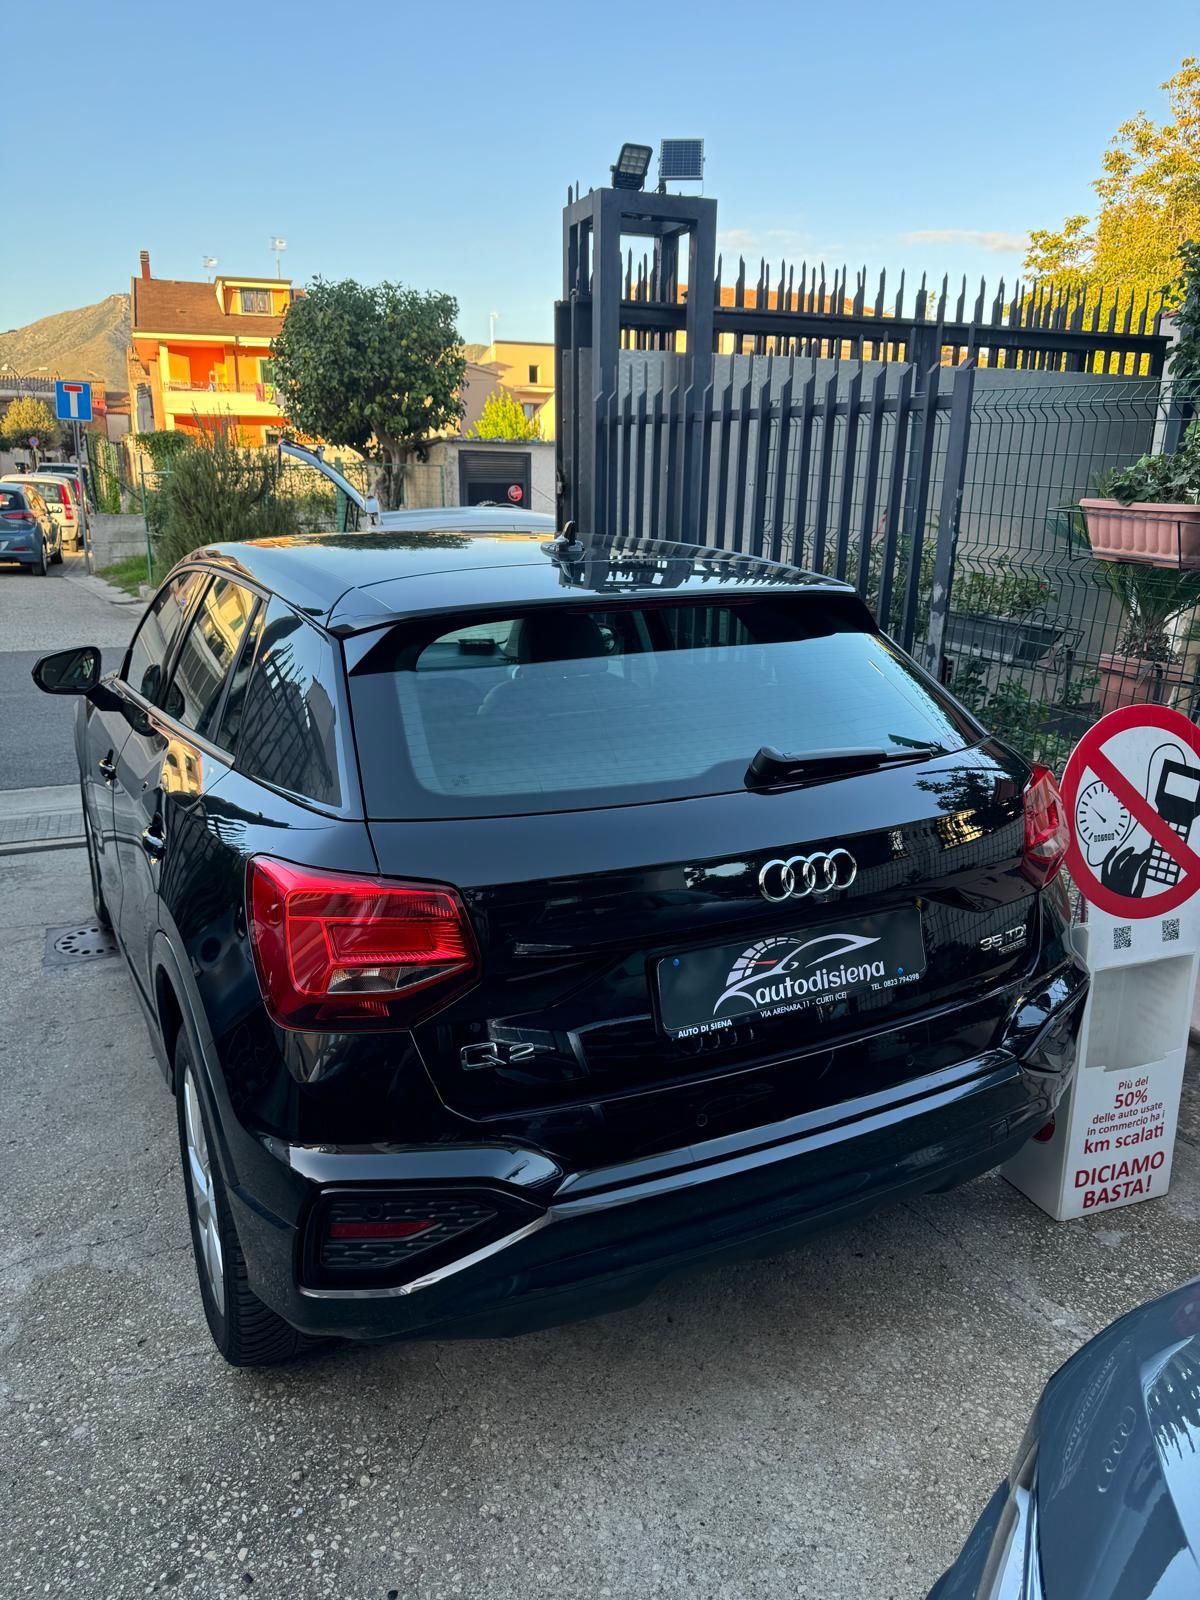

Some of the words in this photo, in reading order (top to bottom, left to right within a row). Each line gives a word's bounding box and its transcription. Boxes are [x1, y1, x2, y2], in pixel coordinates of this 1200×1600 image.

[980, 934, 1003, 951] 35
[755, 961, 885, 1004] autodisiena
[871, 983, 882, 991] TEL.
[884, 978, 898, 988] 0823
[760, 1008, 772, 1018] VIA
[816, 994, 834, 1005] CURTI
[678, 1027, 699, 1038] AUTO
[701, 1024, 710, 1033] DI
[711, 1019, 732, 1031] SIENA
[460, 1042, 535, 1070] Q2
[1118, 1079, 1133, 1090] Più
[1135, 1075, 1149, 1087] del
[1114, 1087, 1148, 1109] 50%
[1086, 1127, 1096, 1137] in
[1098, 1115, 1148, 1134] commercio
[1149, 1113, 1160, 1122] ha
[1161, 1109, 1166, 1119] i
[1092, 1111, 1116, 1125] delle
[1118, 1108, 1139, 1119] auto
[1140, 1102, 1163, 1115] usate
[1083, 1139, 1111, 1154] km
[1115, 1121, 1165, 1149] scalati
[1074, 1151, 1165, 1188] DICIAMO
[1082, 1174, 1152, 1209] BASTA!
